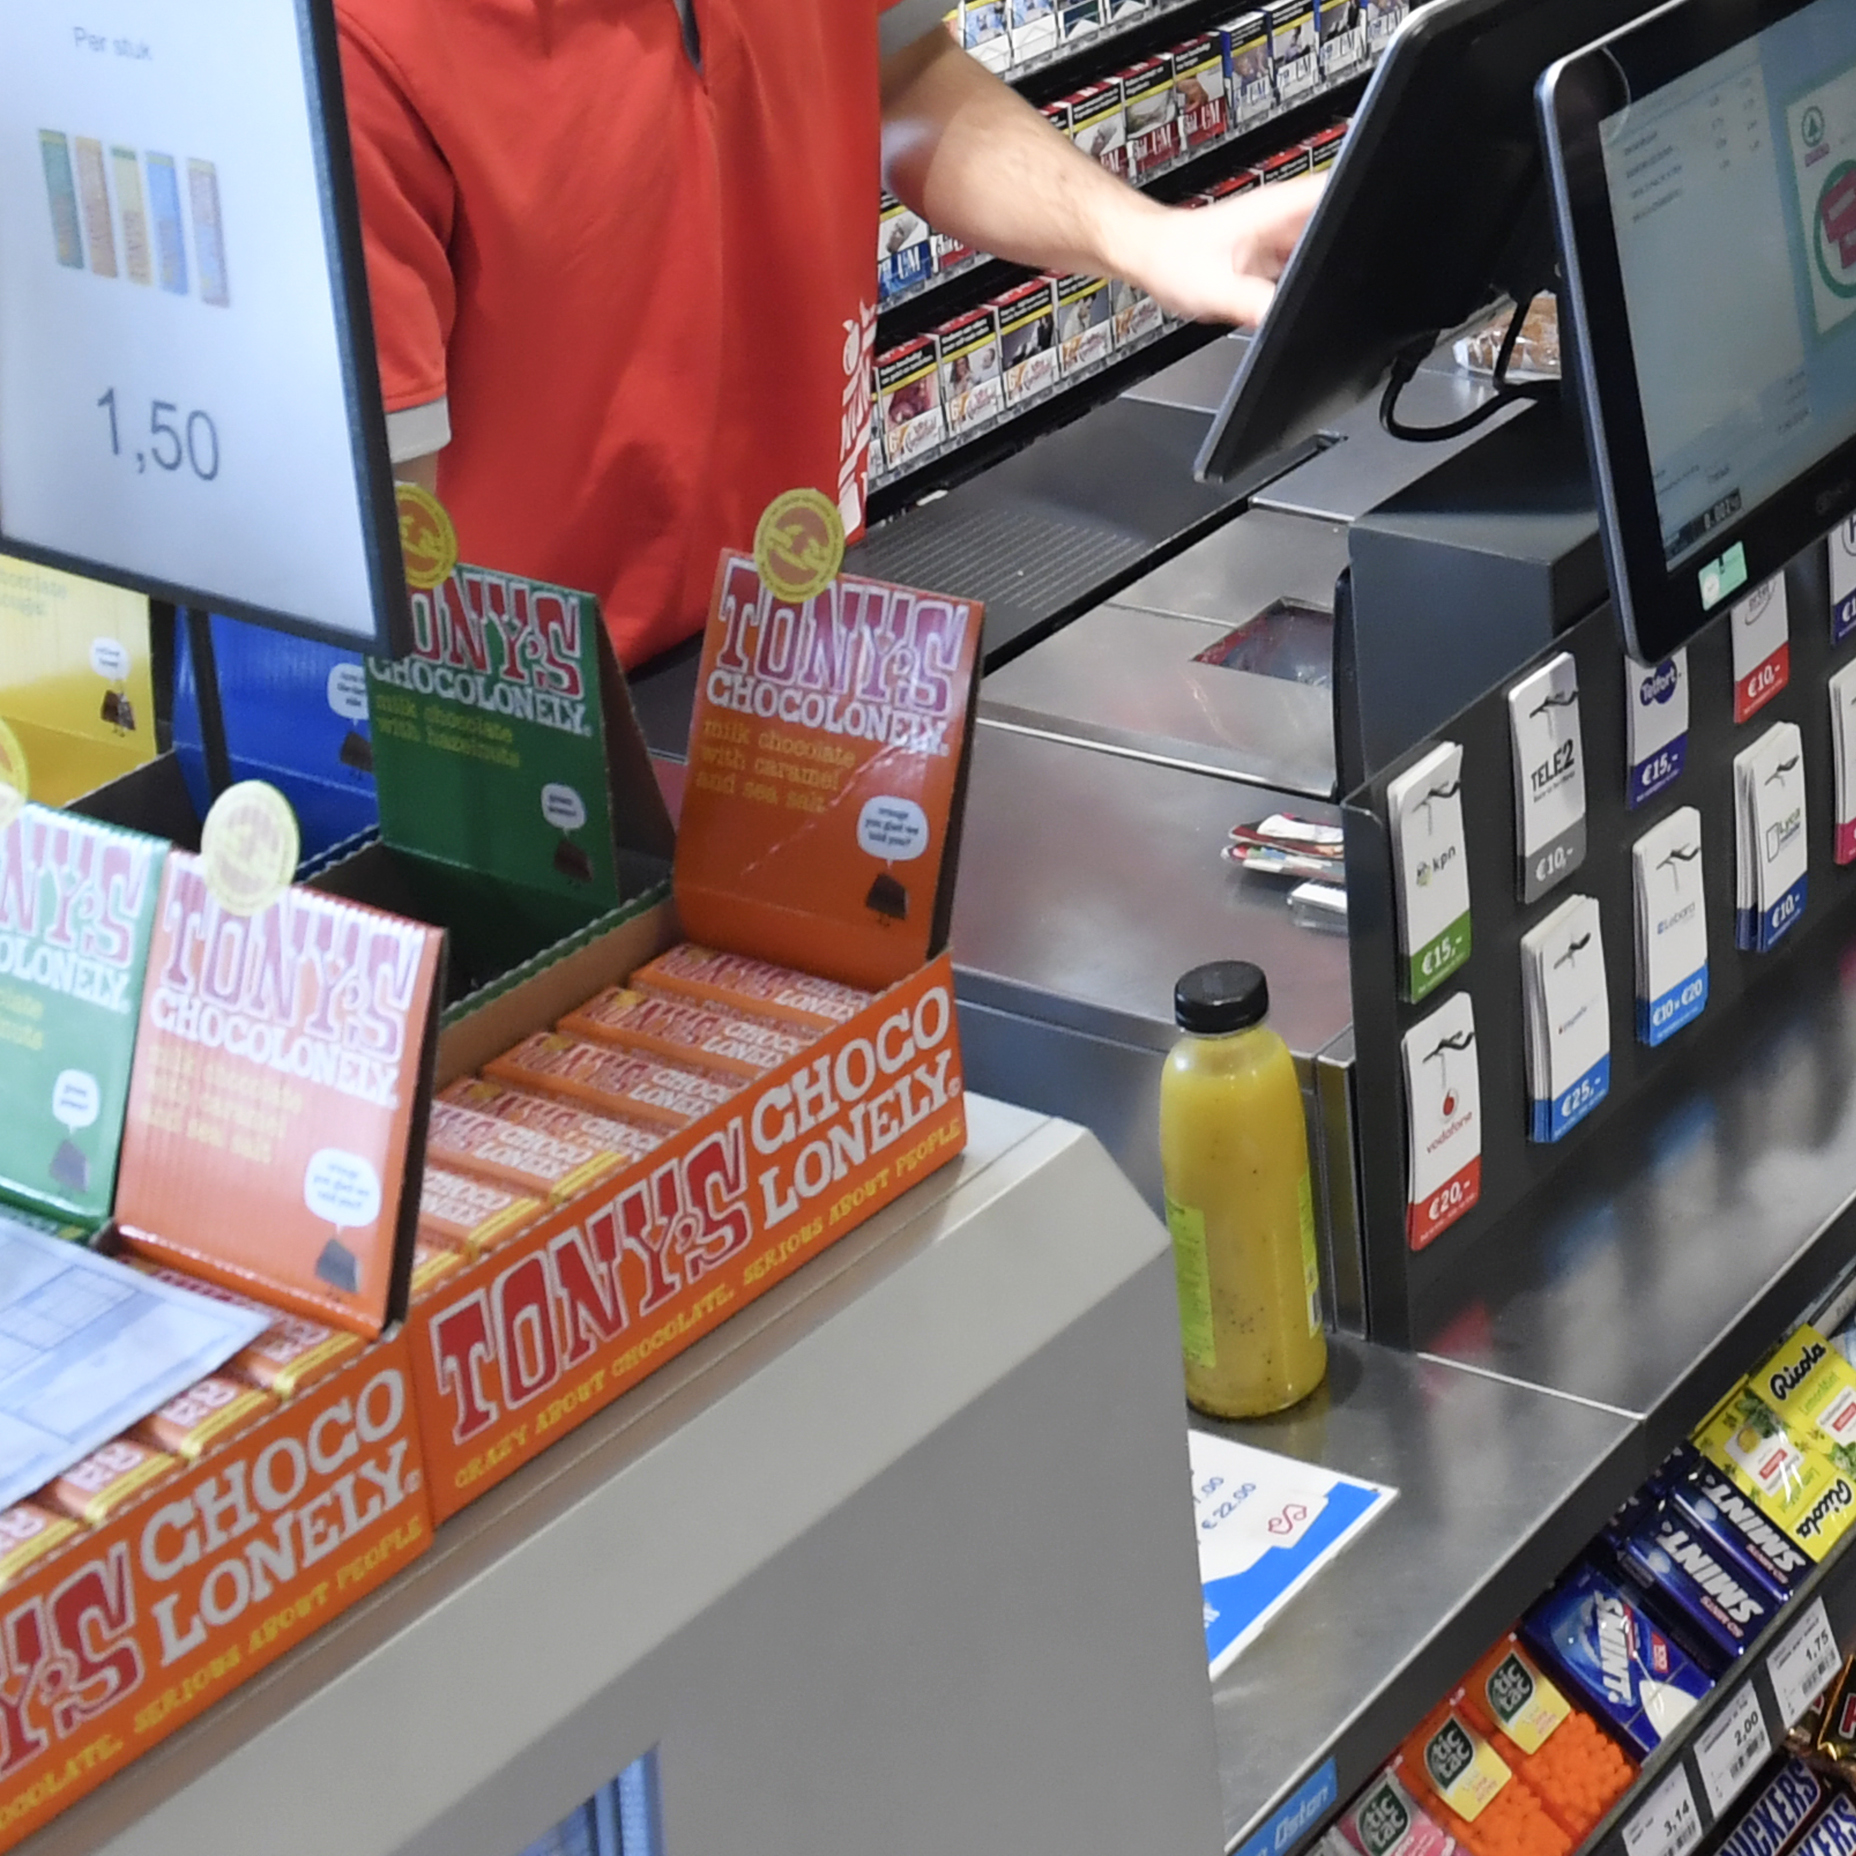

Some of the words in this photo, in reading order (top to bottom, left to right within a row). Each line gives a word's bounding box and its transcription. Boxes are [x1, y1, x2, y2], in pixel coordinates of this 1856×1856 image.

[96, 387, 219, 482] 1,50
[407, 570, 583, 699] ONY'S
[716, 556, 969, 716] TONY'S
[1640, 663, 1681, 700] Telfort
[1748, 664, 1781, 699] €10,-
[707, 670, 948, 756] CHOCOLONELY
[704, 720, 749, 744] milk
[759, 731, 855, 767] chocolate
[704, 747, 746, 770] with
[755, 757, 839, 790] caramel
[1531, 739, 1575, 792] TELE2
[1641, 752, 1680, 787] €15,-
[696, 770, 735, 793] and
[742, 781, 777, 804] sea
[785, 790, 826, 813] salt
[1777, 807, 1801, 835] Lyca
[1432, 846, 1456, 873] kpn
[1535, 846, 1574, 884] €10,-
[1771, 893, 1800, 930] €10,-
[160, 862, 425, 1062] TONY'S
[1421, 937, 1462, 977] €15,-
[150, 987, 399, 1110] CHOCOLONELY
[751, 986, 950, 1156] CHOCO
[1561, 1076, 1603, 1119] €25,-
[501, 1126, 594, 1165] CHOCO
[758, 1051, 952, 1231] LONELY
[1426, 1110, 1474, 1154] vodafone
[1428, 1179, 1471, 1221] €20,-
[428, 1115, 757, 1447] TONY'S
[455, 1427, 529, 1491] CRAZY
[535, 1372, 607, 1434] ABOUT
[611, 1285, 736, 1378] CHOCOLATE.
[743, 1217, 823, 1285] SERIOUS
[829, 1169, 890, 1234] ABOUT
[896, 1119, 962, 1178] PEOPLE
[1769, 1343, 1826, 1400] Ricola
[140, 1369, 405, 1581] CHOCO
[1212, 1483, 1257, 1521] 22.00
[1797, 1479, 1852, 1538] Ricola
[1702, 1481, 1806, 1573] SMINT
[152, 1439, 409, 1667] LONELY
[1657, 1530, 1763, 1624] SMINT
[135, 1648, 239, 1733] SERIOUS
[248, 1581, 330, 1655] ABOUT
[337, 1516, 423, 1591] PEOPLE
[1805, 1631, 1829, 1661] 1,75
[1494, 1663, 1520, 1697] tic
[1499, 1679, 1533, 1718] tac
[1433, 1730, 1459, 1763] tic
[1734, 1713, 1759, 1746] 2,00
[1439, 1746, 1472, 1786] tac
[1365, 1793, 1392, 1823] tic
[1371, 1810, 1405, 1849] tac
[1664, 1804, 1689, 1836] 3,14
[1718, 1762, 1820, 1856] NICKERS
